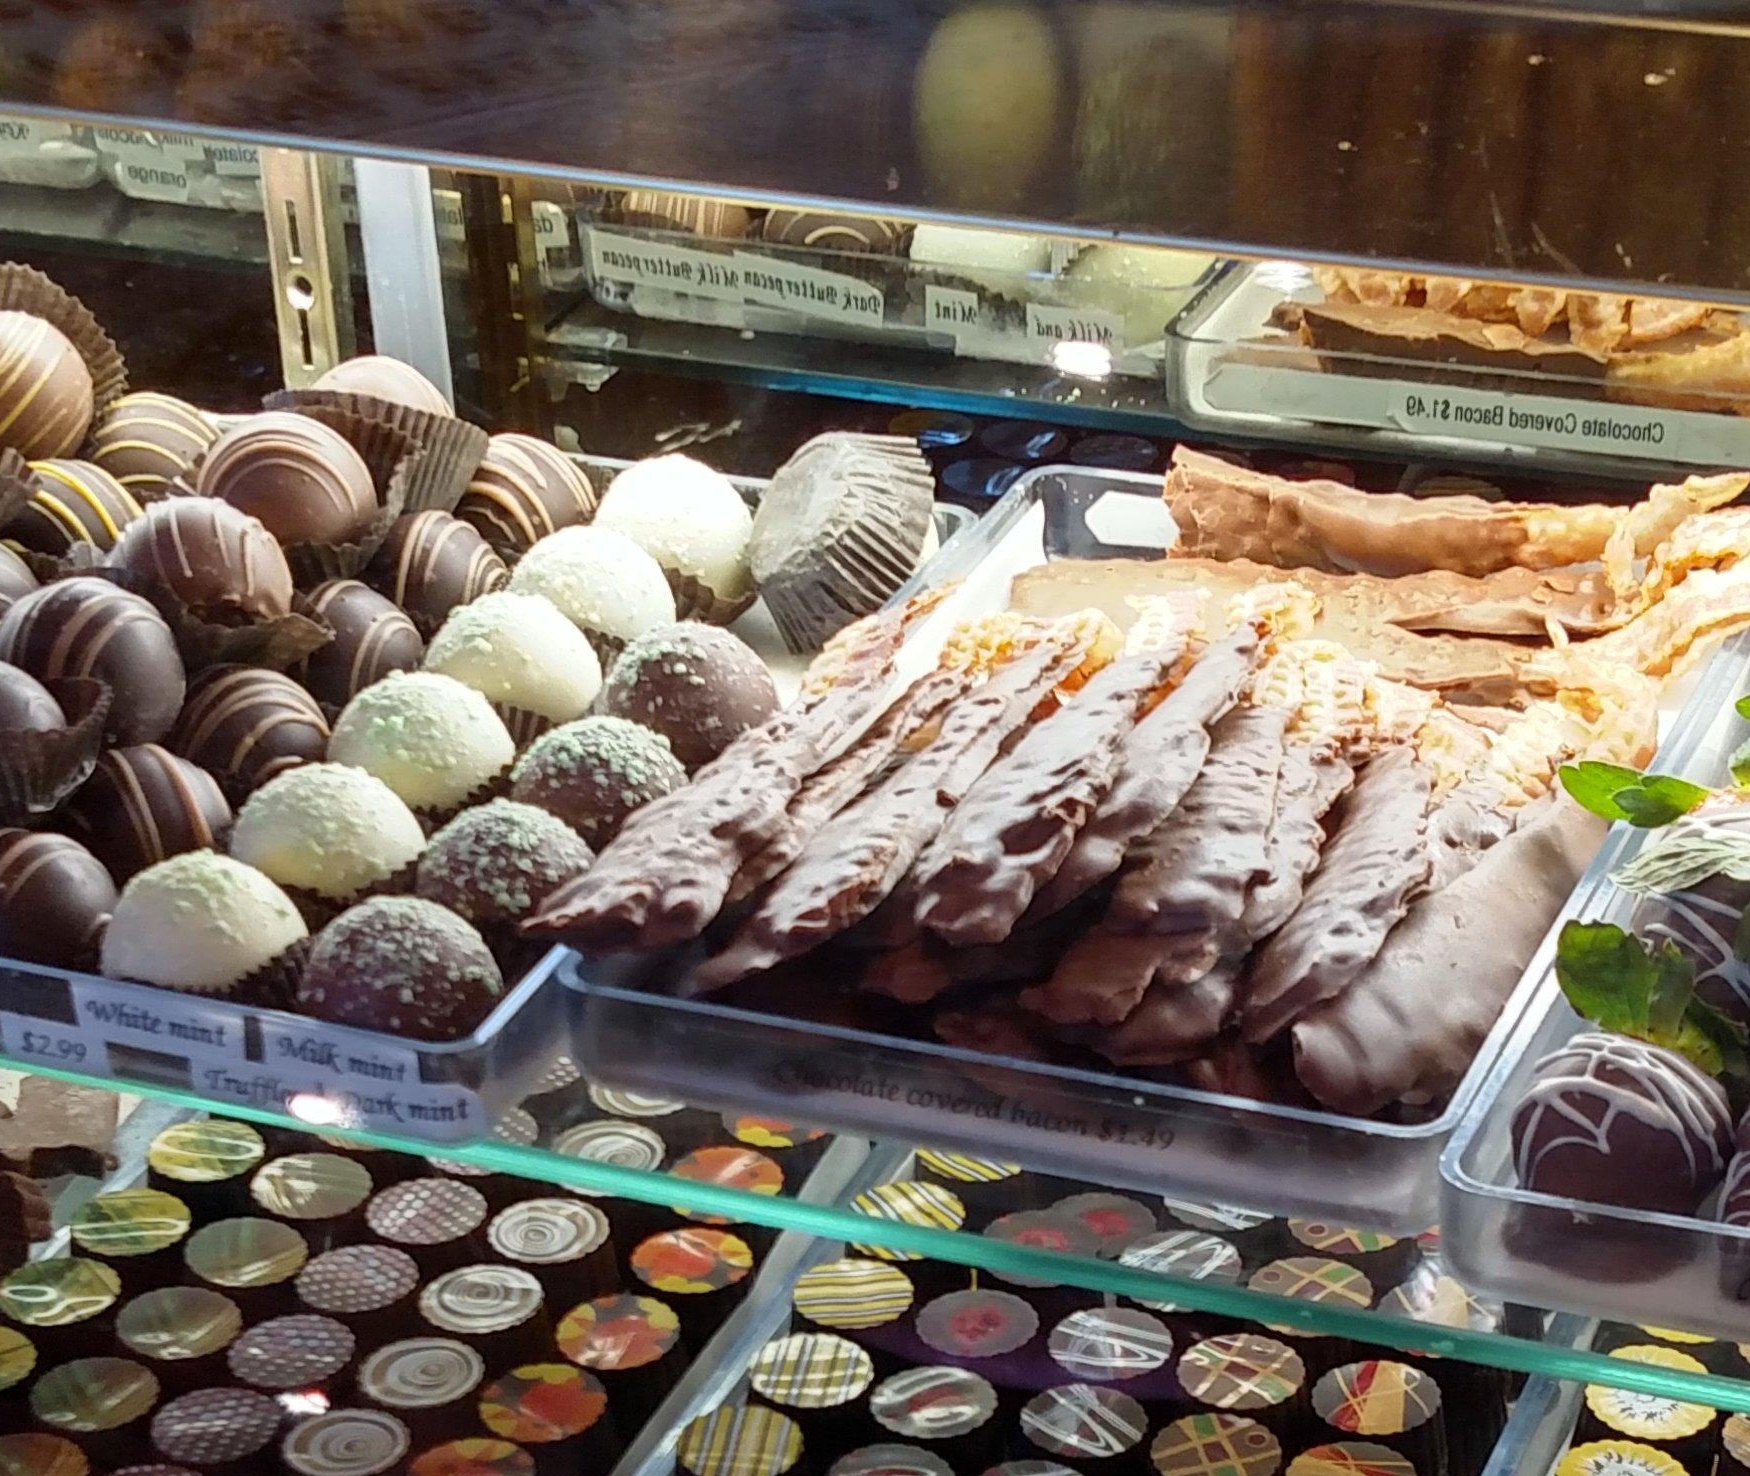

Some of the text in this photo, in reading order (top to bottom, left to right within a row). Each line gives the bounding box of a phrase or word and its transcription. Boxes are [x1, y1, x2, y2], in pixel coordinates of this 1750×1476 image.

[21, 1032, 87, 1063] $2.99
[85, 1000, 410, 1083] White mint Milk mint
[408, 1098, 470, 1122] mint
[905, 1089, 1000, 1120] covered
[1009, 1100, 1089, 1137] bacon
[1095, 1121, 1177, 1150] $1.49
